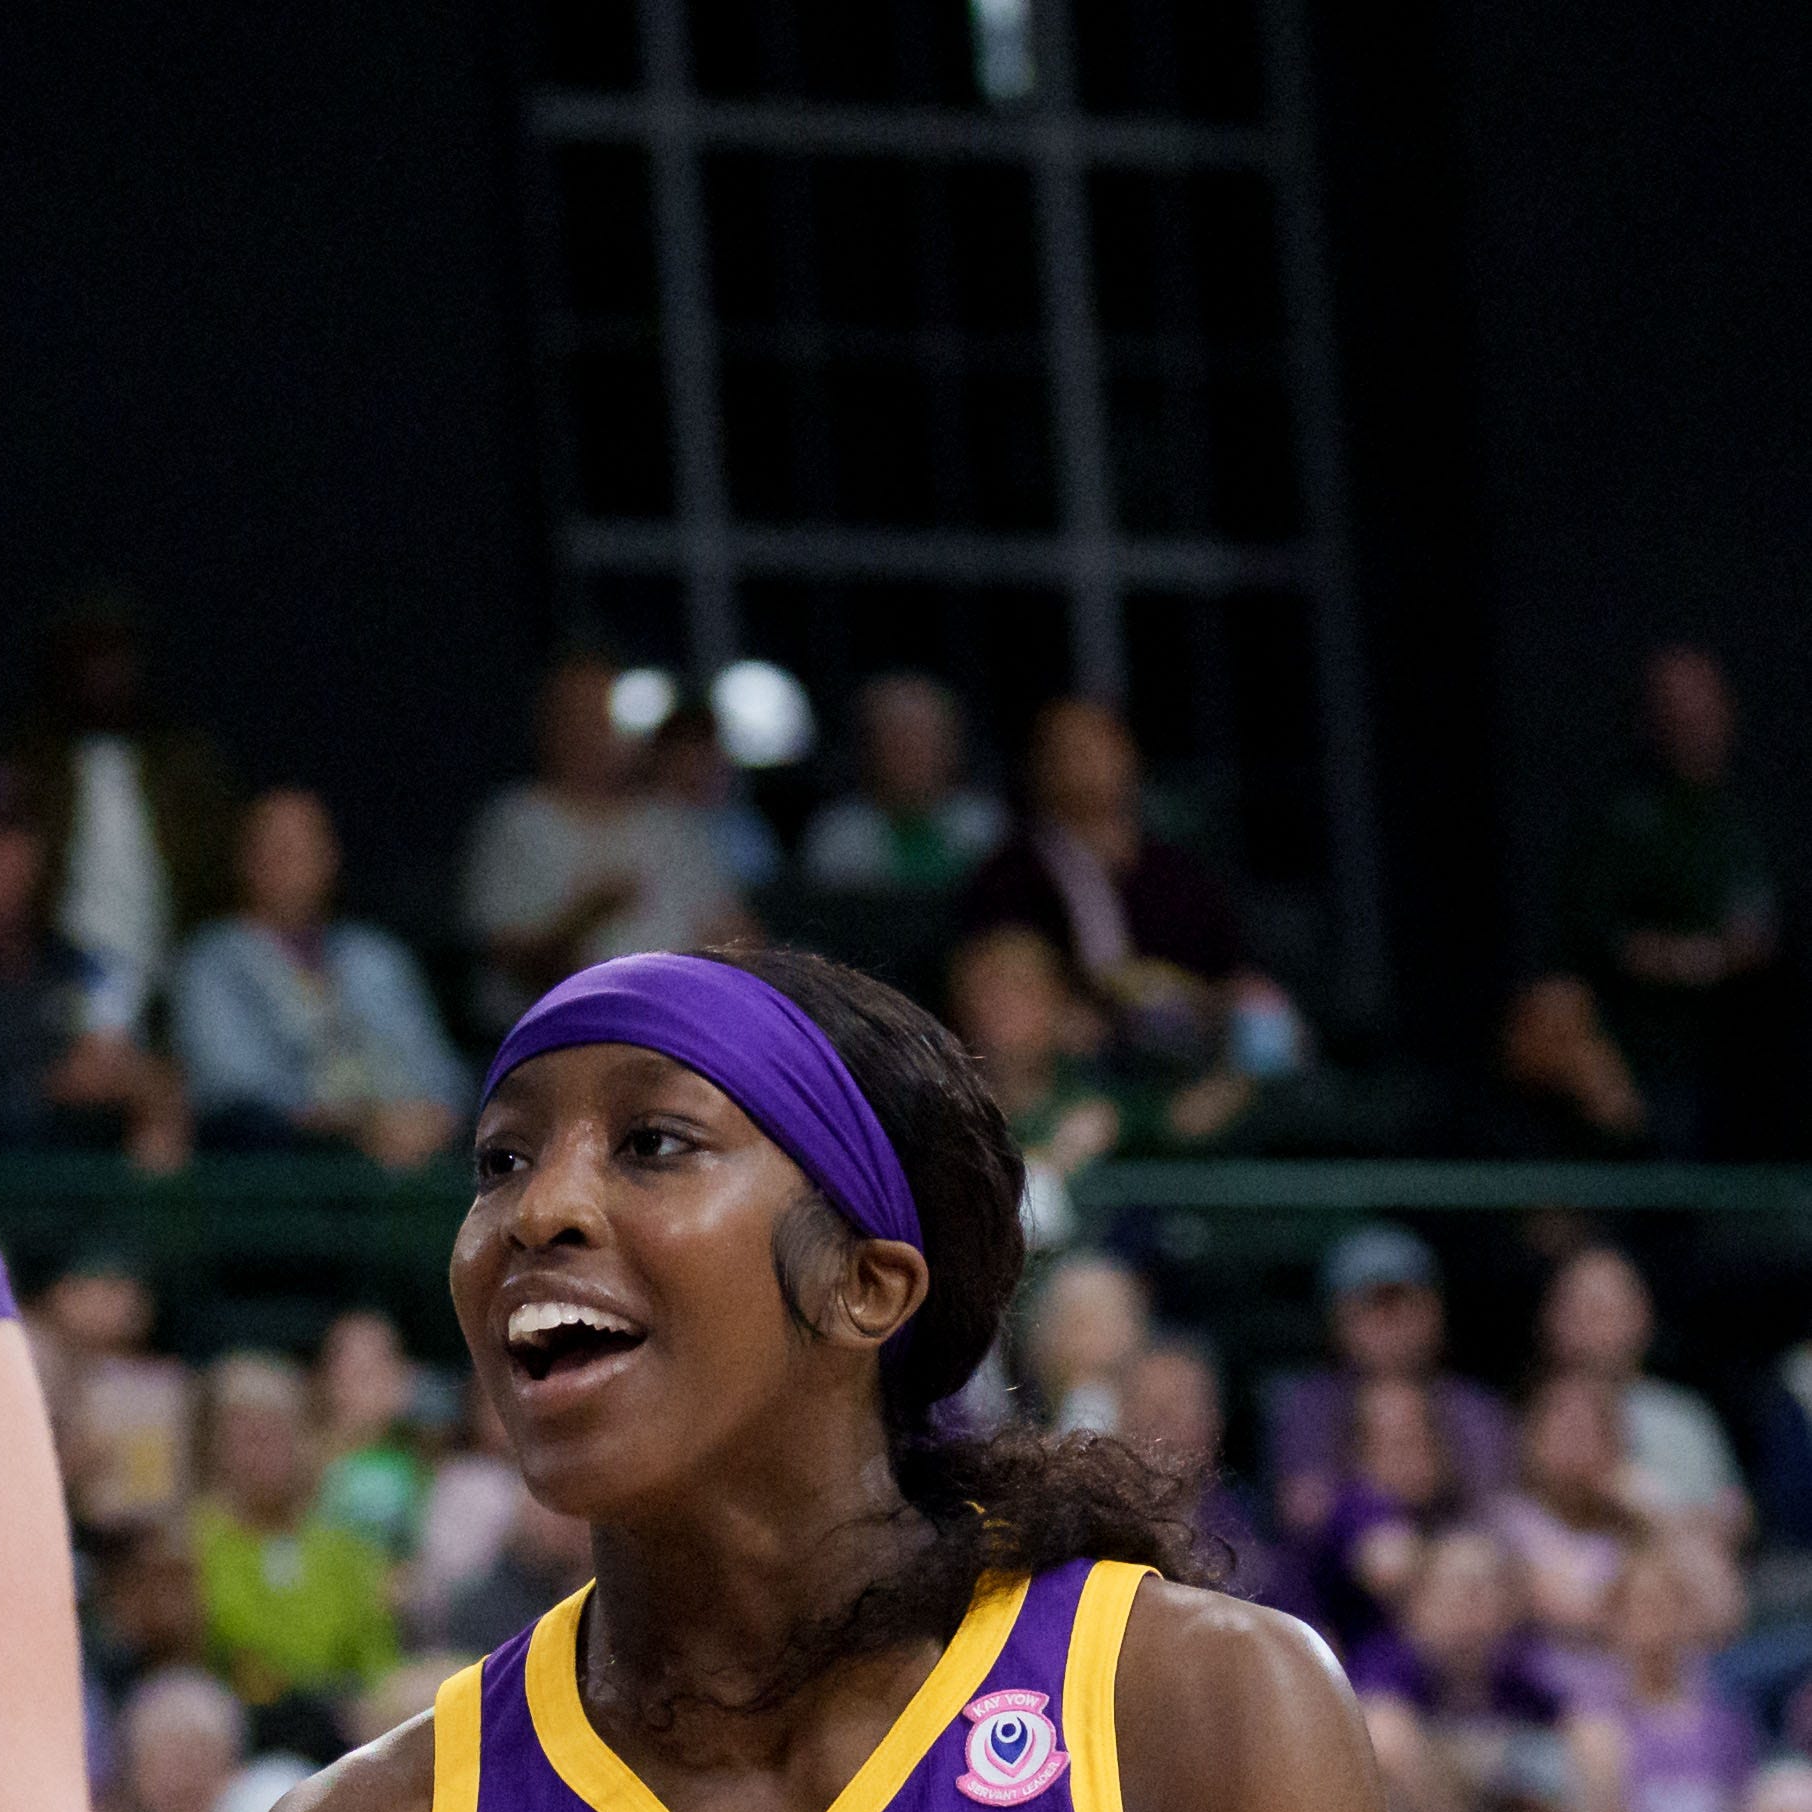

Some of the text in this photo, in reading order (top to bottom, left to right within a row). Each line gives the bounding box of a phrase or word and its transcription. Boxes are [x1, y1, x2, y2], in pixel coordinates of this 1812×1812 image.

[972, 1693, 1040, 1718] KAY YOW
[966, 1761, 1061, 1801] SERVANT LEADER
